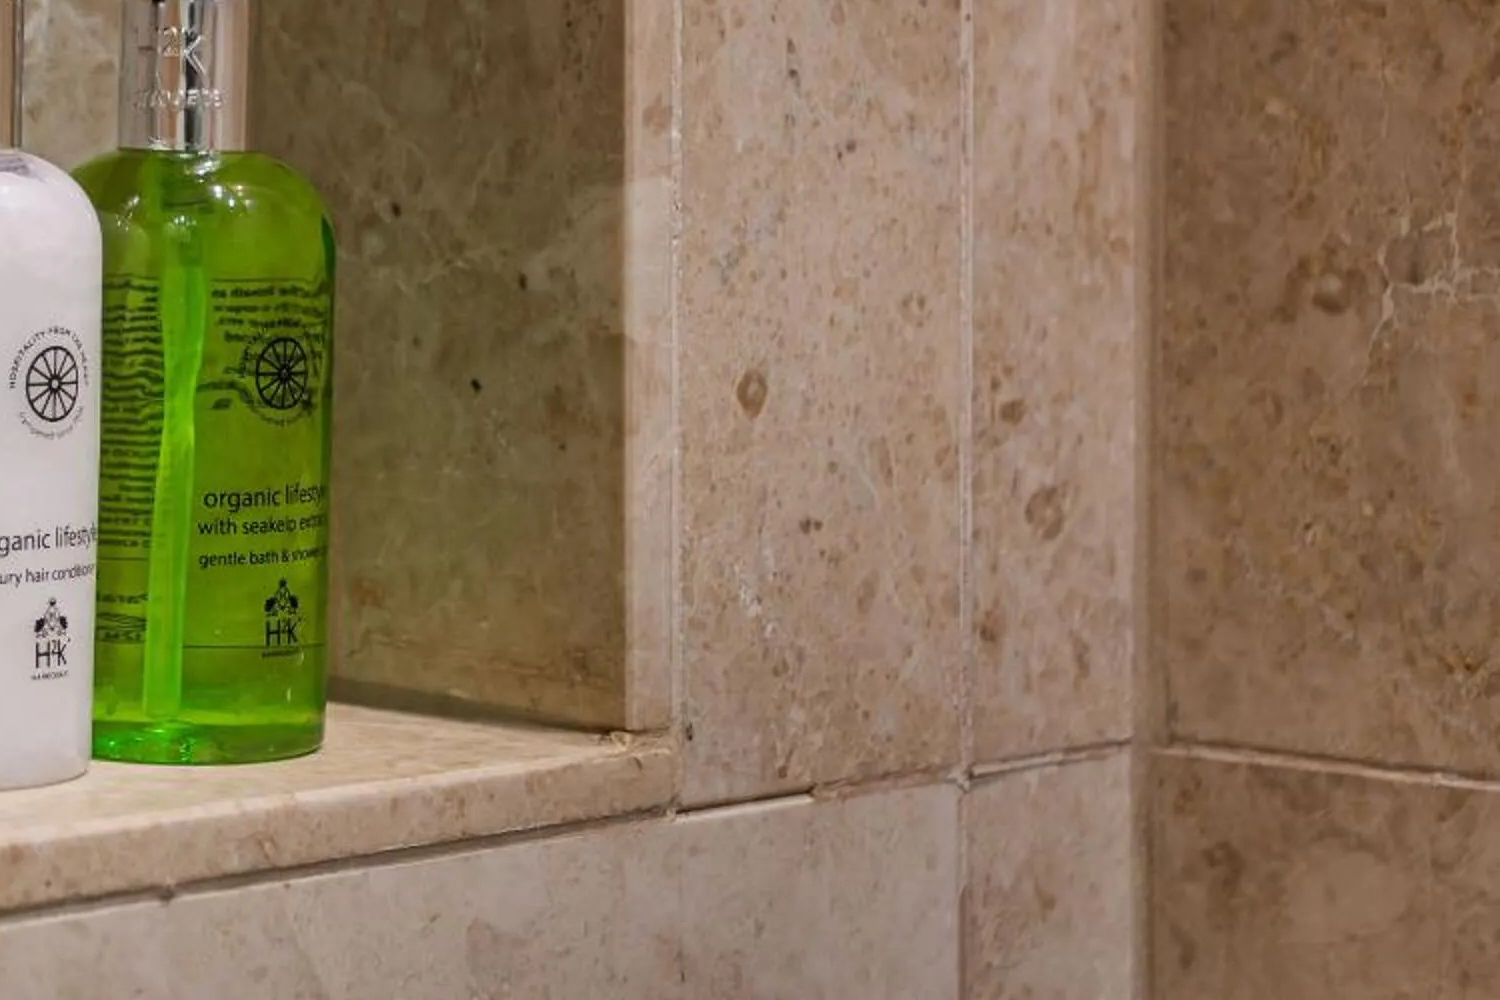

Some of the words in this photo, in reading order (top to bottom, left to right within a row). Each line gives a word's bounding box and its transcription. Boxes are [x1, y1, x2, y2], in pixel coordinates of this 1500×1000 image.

[203, 487, 281, 513] organic
[197, 516, 237, 535] with
[242, 515, 297, 535] seakelp
[199, 552, 247, 569] gentle
[249, 549, 279, 565] bath
[25, 567, 50, 584] hair
